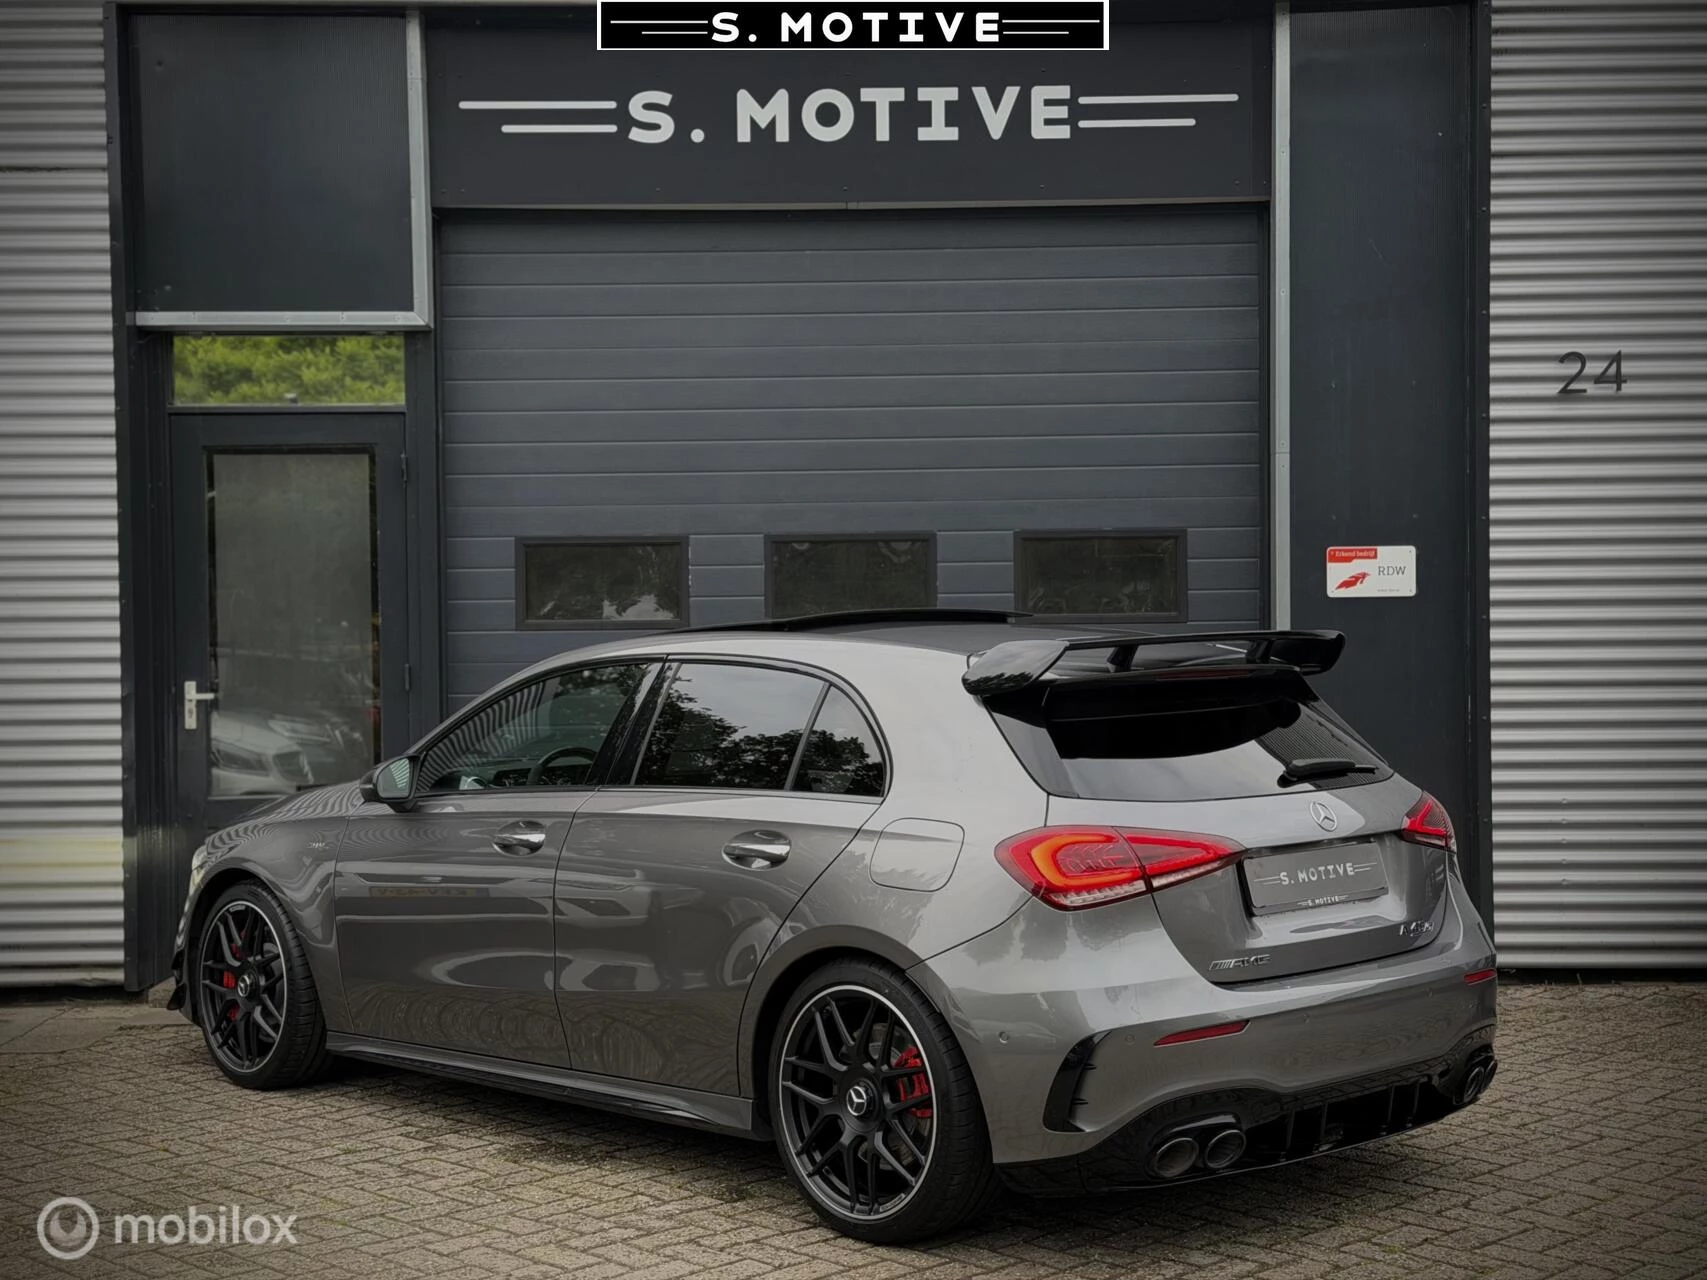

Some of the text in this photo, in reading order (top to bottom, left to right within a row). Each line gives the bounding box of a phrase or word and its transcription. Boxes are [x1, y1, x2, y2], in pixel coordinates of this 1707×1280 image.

[627, 85, 1072, 144] S. MOTIVE
[1557, 349, 1628, 394] 24
[1356, 550, 1376, 558] bedrijf
[1377, 565, 1407, 577] RDW
[1279, 862, 1355, 886] S. MOTIVE
[1314, 895, 1340, 905] MOTIVE
